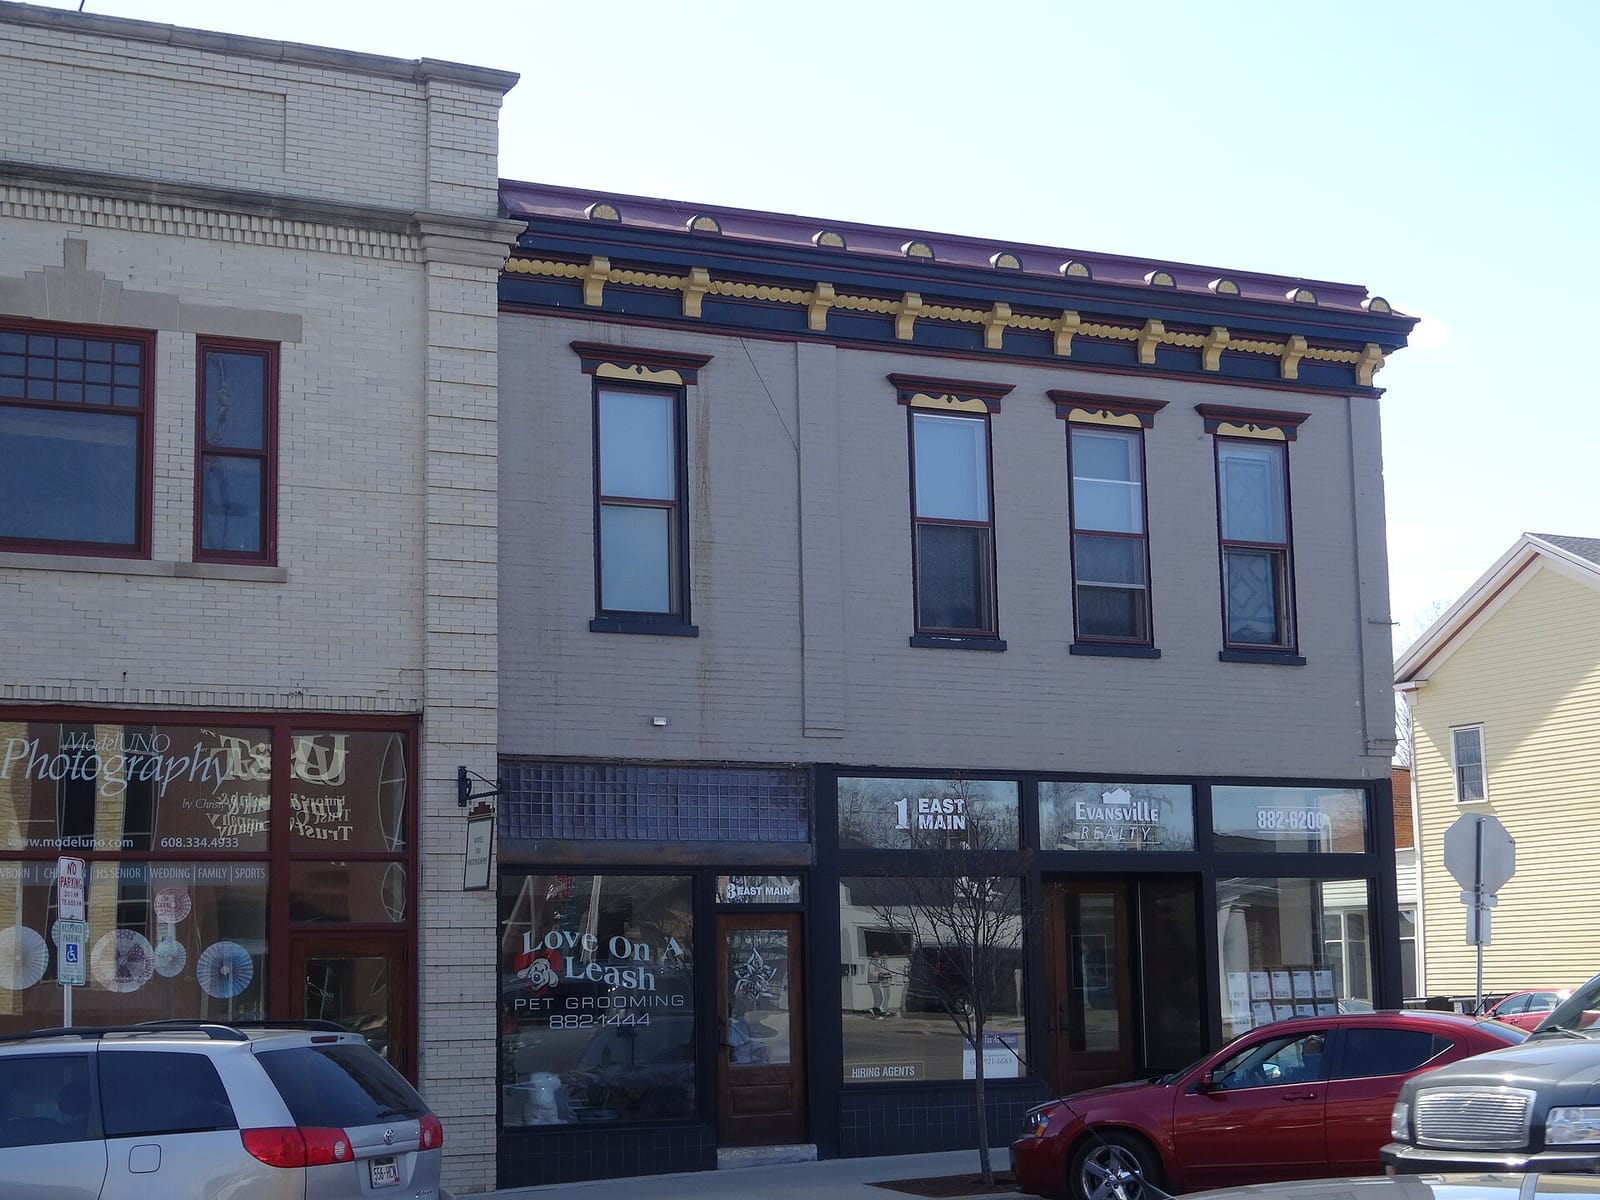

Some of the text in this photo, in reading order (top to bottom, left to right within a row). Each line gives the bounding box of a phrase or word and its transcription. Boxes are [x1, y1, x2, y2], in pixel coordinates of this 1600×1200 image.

[63, 732, 171, 753] ModelUNO
[0, 737, 233, 798] Photography
[894, 798, 910, 829] 1
[918, 798, 965, 814] EAST
[918, 815, 966, 830] MAIN
[1257, 811, 1325, 829] 882-6200
[1080, 826, 1151, 840] REALTY
[7, 836, 239, 849] www.modeluno.com 608.334.4933
[67, 863, 77, 875] NO
[109, 868, 141, 879] SENIOR
[149, 867, 190, 879] WEDDING
[198, 868, 228, 879] FAMILY
[234, 868, 266, 879] SPORTS
[60, 876, 82, 889] PARKING
[727, 883, 790, 899] 3 EAST MAIN
[522, 930, 684, 961] Love On A
[564, 956, 656, 991] Leash
[514, 994, 685, 1011] PET GROOMING
[550, 1012, 651, 1030] 882-1444
[852, 1066, 915, 1078] HIRING AGENTS
